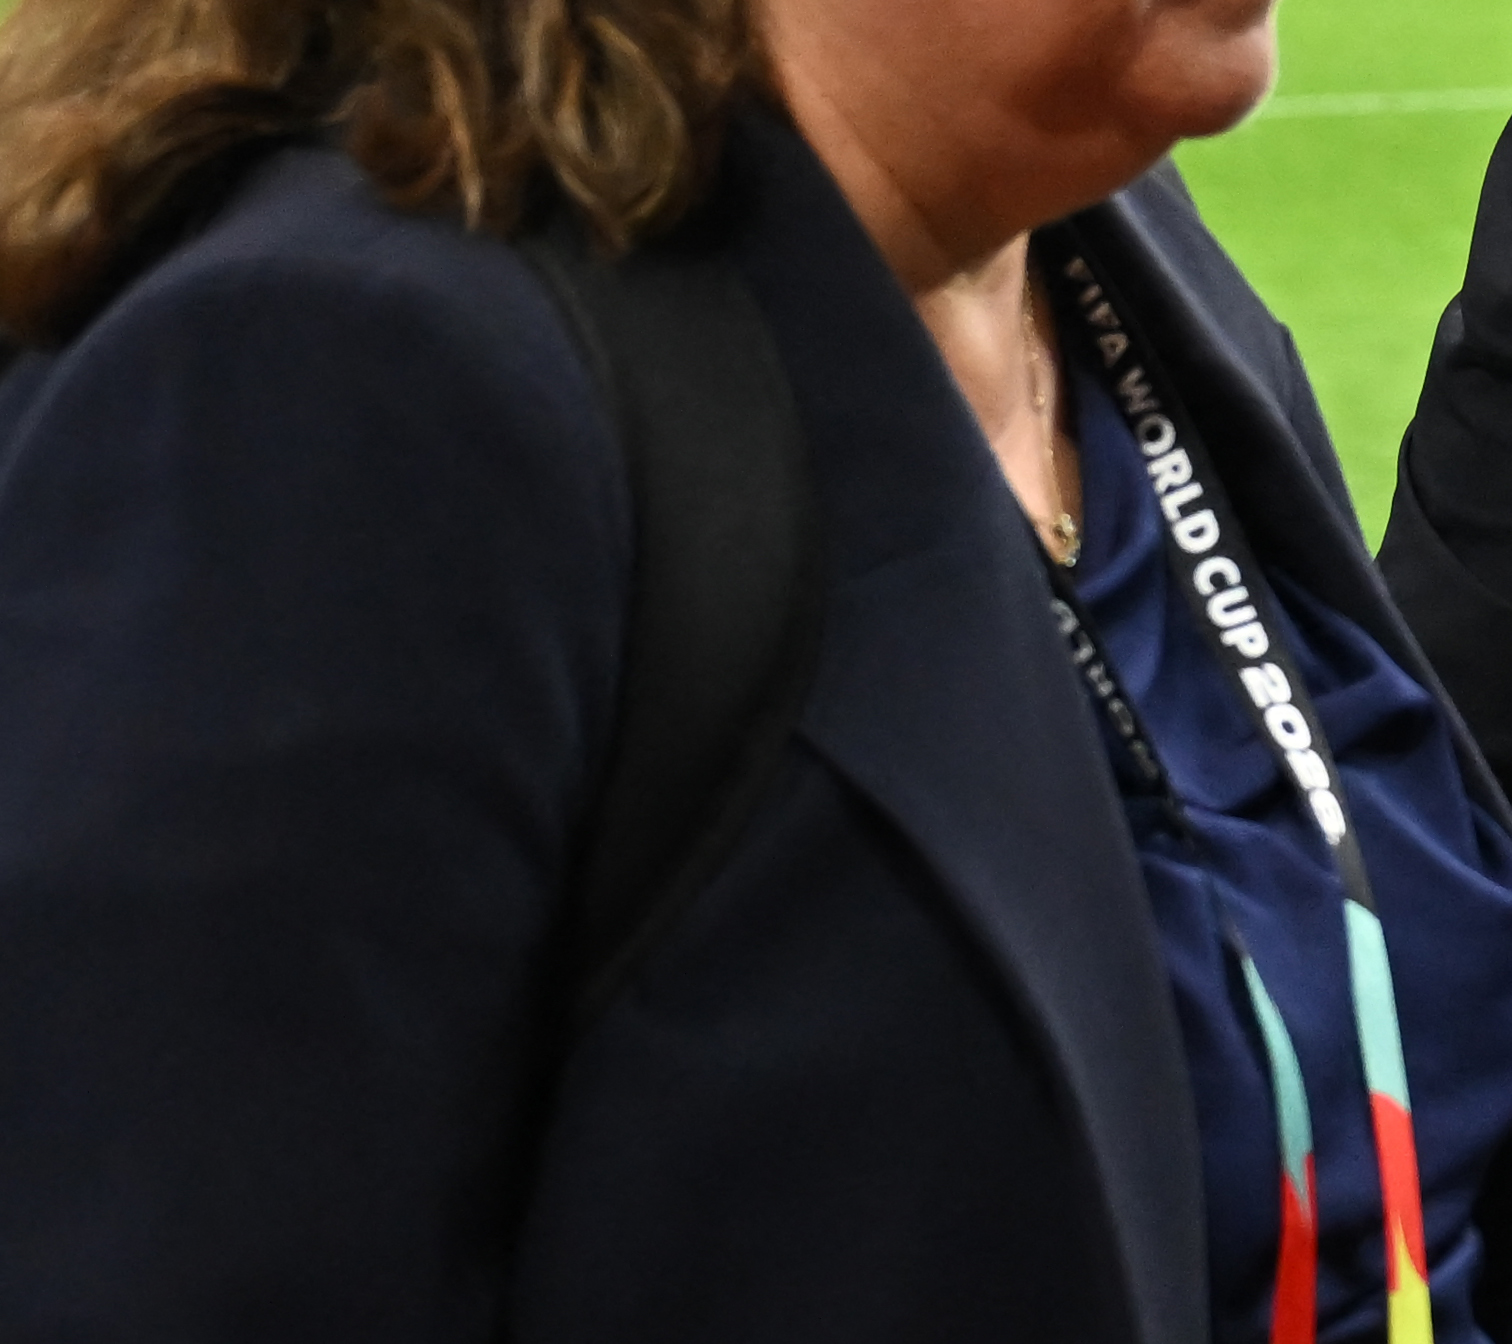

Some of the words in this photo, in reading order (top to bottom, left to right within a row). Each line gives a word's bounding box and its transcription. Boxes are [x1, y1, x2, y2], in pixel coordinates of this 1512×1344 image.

[1116, 367, 1221, 555] WORLD
[1192, 555, 1270, 659] CUP
[1237, 660, 1346, 840] 2026
